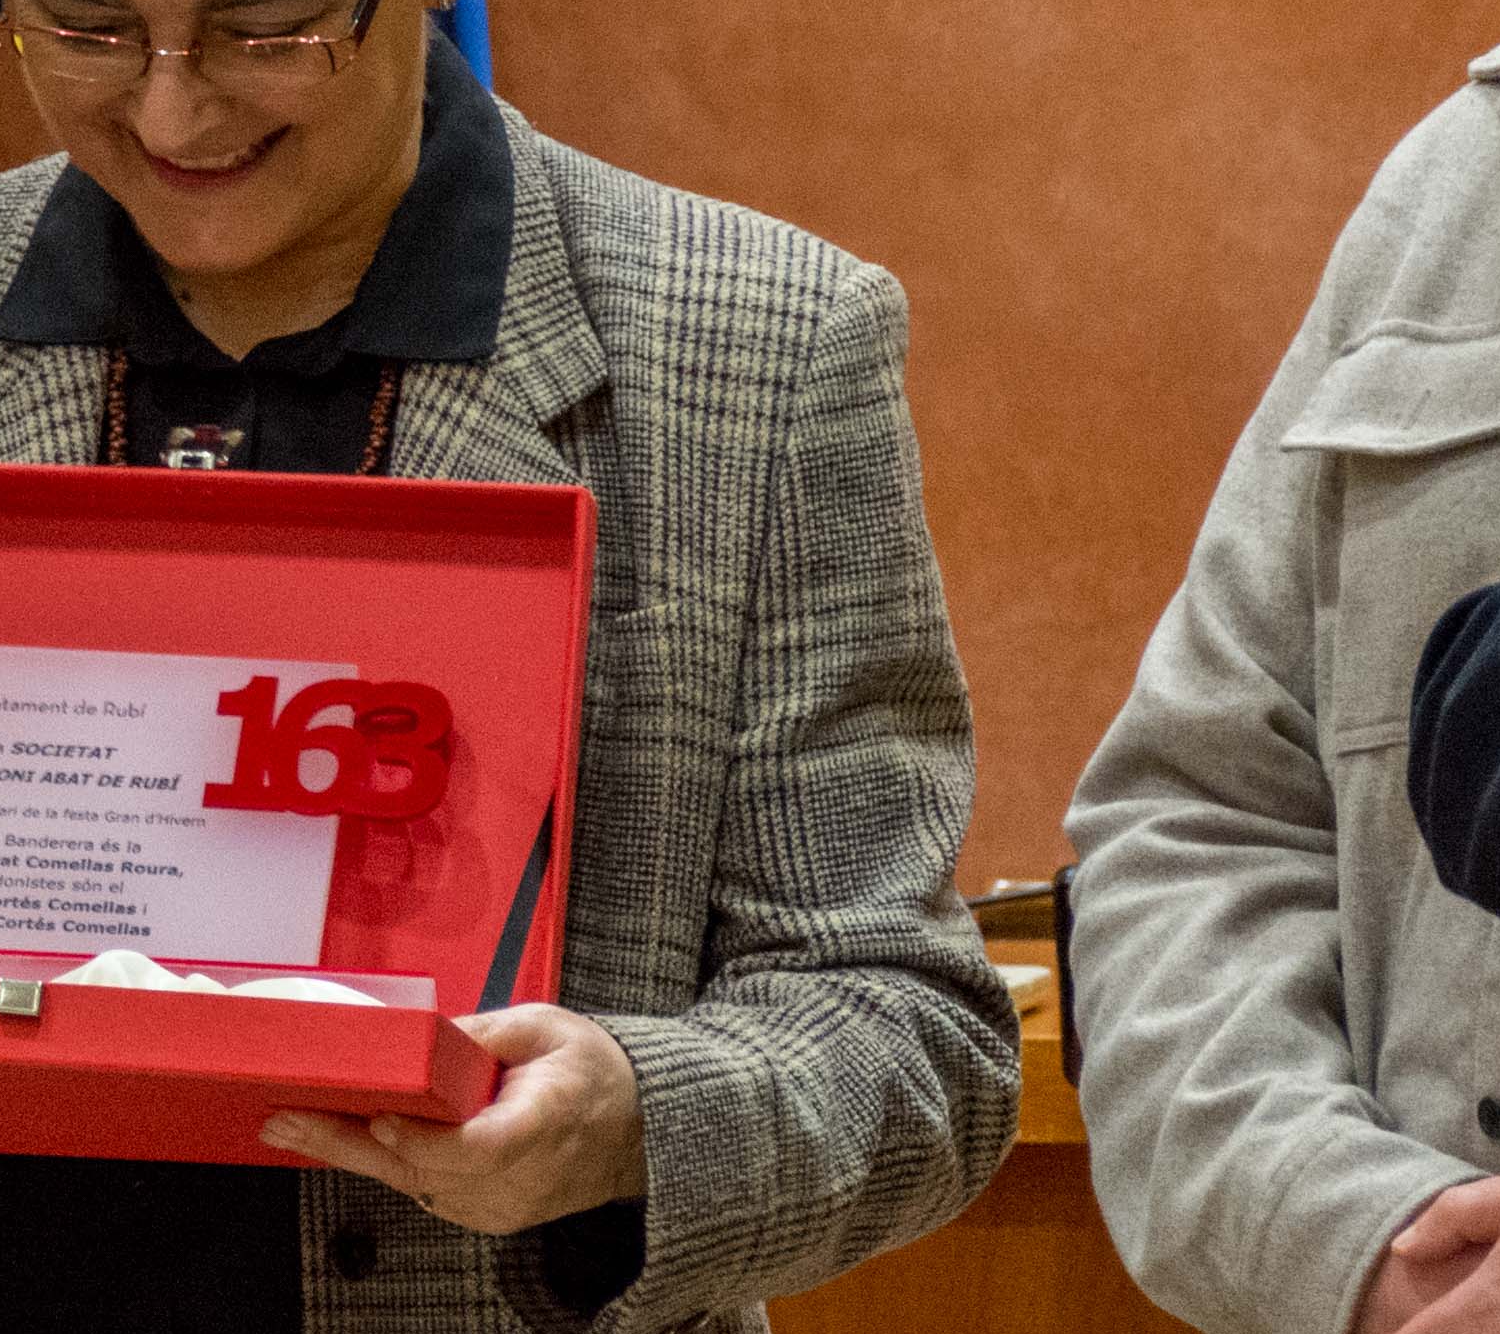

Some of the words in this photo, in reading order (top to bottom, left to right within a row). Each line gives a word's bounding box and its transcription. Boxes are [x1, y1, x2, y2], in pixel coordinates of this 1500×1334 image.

[73, 699, 98, 716] de
[104, 700, 147, 718] Rubí
[10, 742, 118, 760] SOCIETAT
[203, 675, 453, 820] 163
[40, 772, 93, 785] ABAT
[98, 775, 126, 787] DE
[129, 774, 182, 790] RUBÍ
[22, 807, 40, 818] de
[46, 809, 58, 819] la
[63, 809, 99, 822] festa
[104, 811, 140, 824] Gran
[145, 813, 206, 827] d'Hivern
[4, 835, 94, 851] Banderera
[101, 838, 120, 853] és
[126, 840, 142, 854] la
[26, 856, 115, 873] Comellas
[120, 861, 183, 878] Roura,
[72, 877, 103, 892] són
[109, 880, 124, 894] el
[48, 899, 137, 915] Comellas
[62, 920, 151, 937] Comellas
